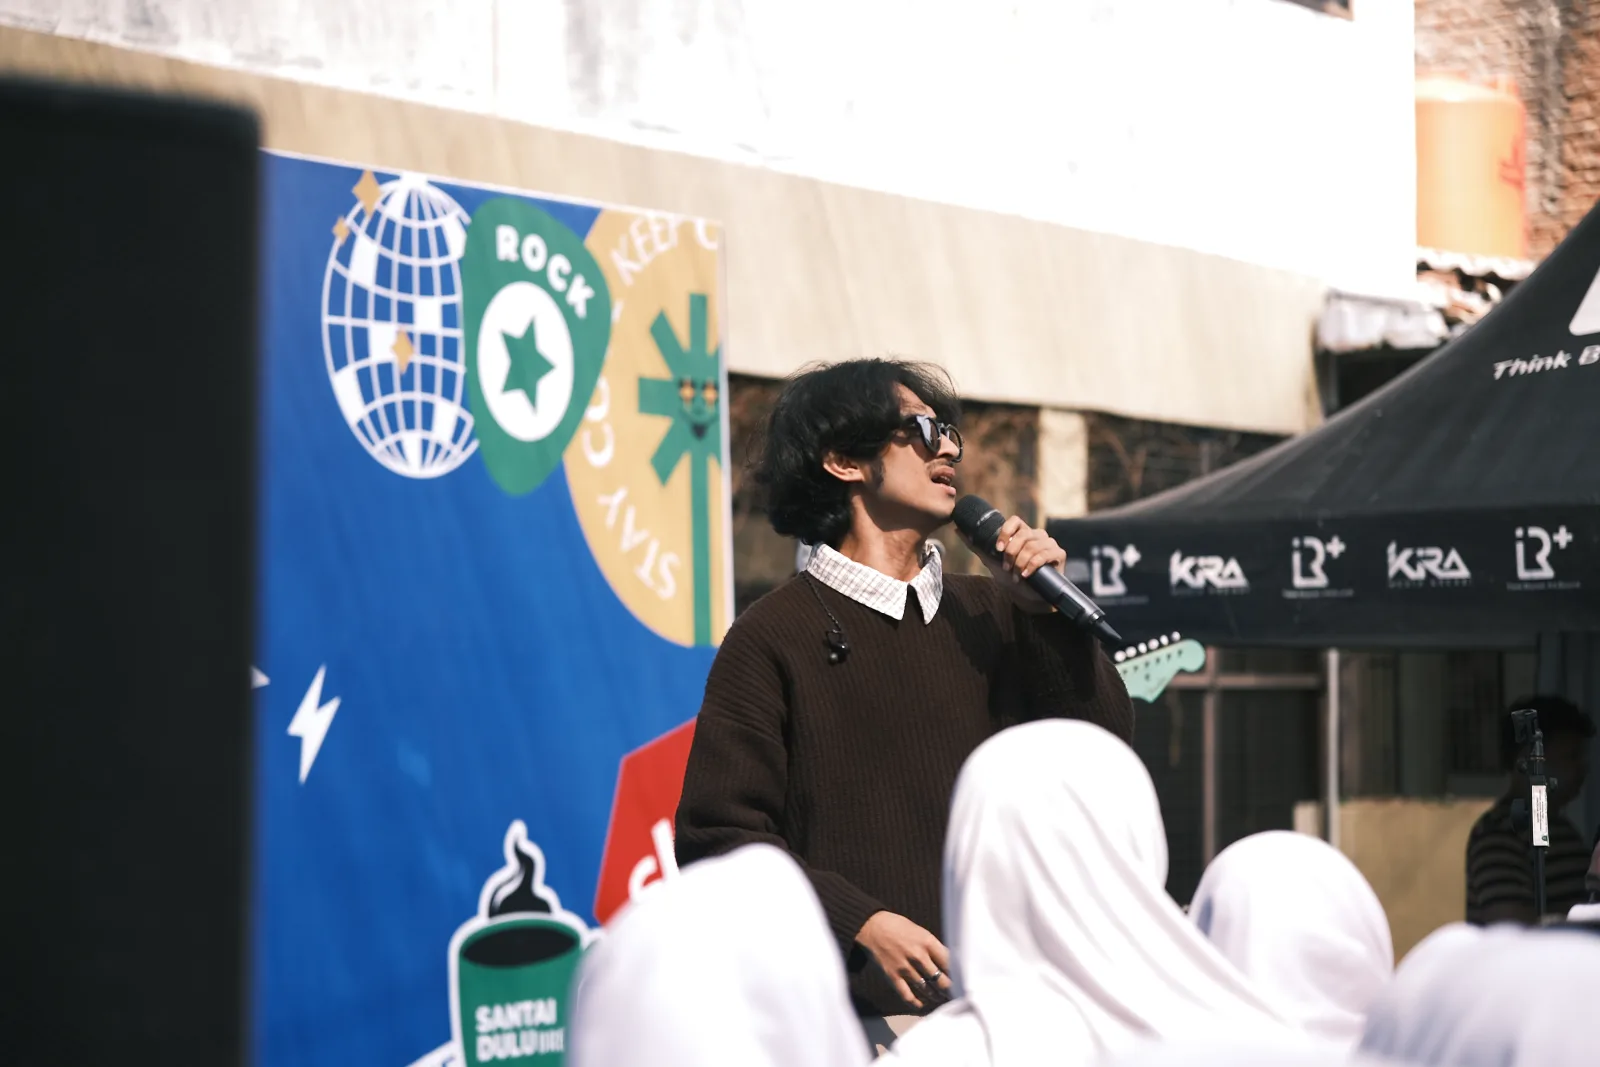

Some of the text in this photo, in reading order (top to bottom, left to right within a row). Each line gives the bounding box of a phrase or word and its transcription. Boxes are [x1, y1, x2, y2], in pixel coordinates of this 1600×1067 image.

[495, 224, 595, 320] ROCK
[1493, 350, 1572, 380] Think
[597, 486, 680, 599] STAY
